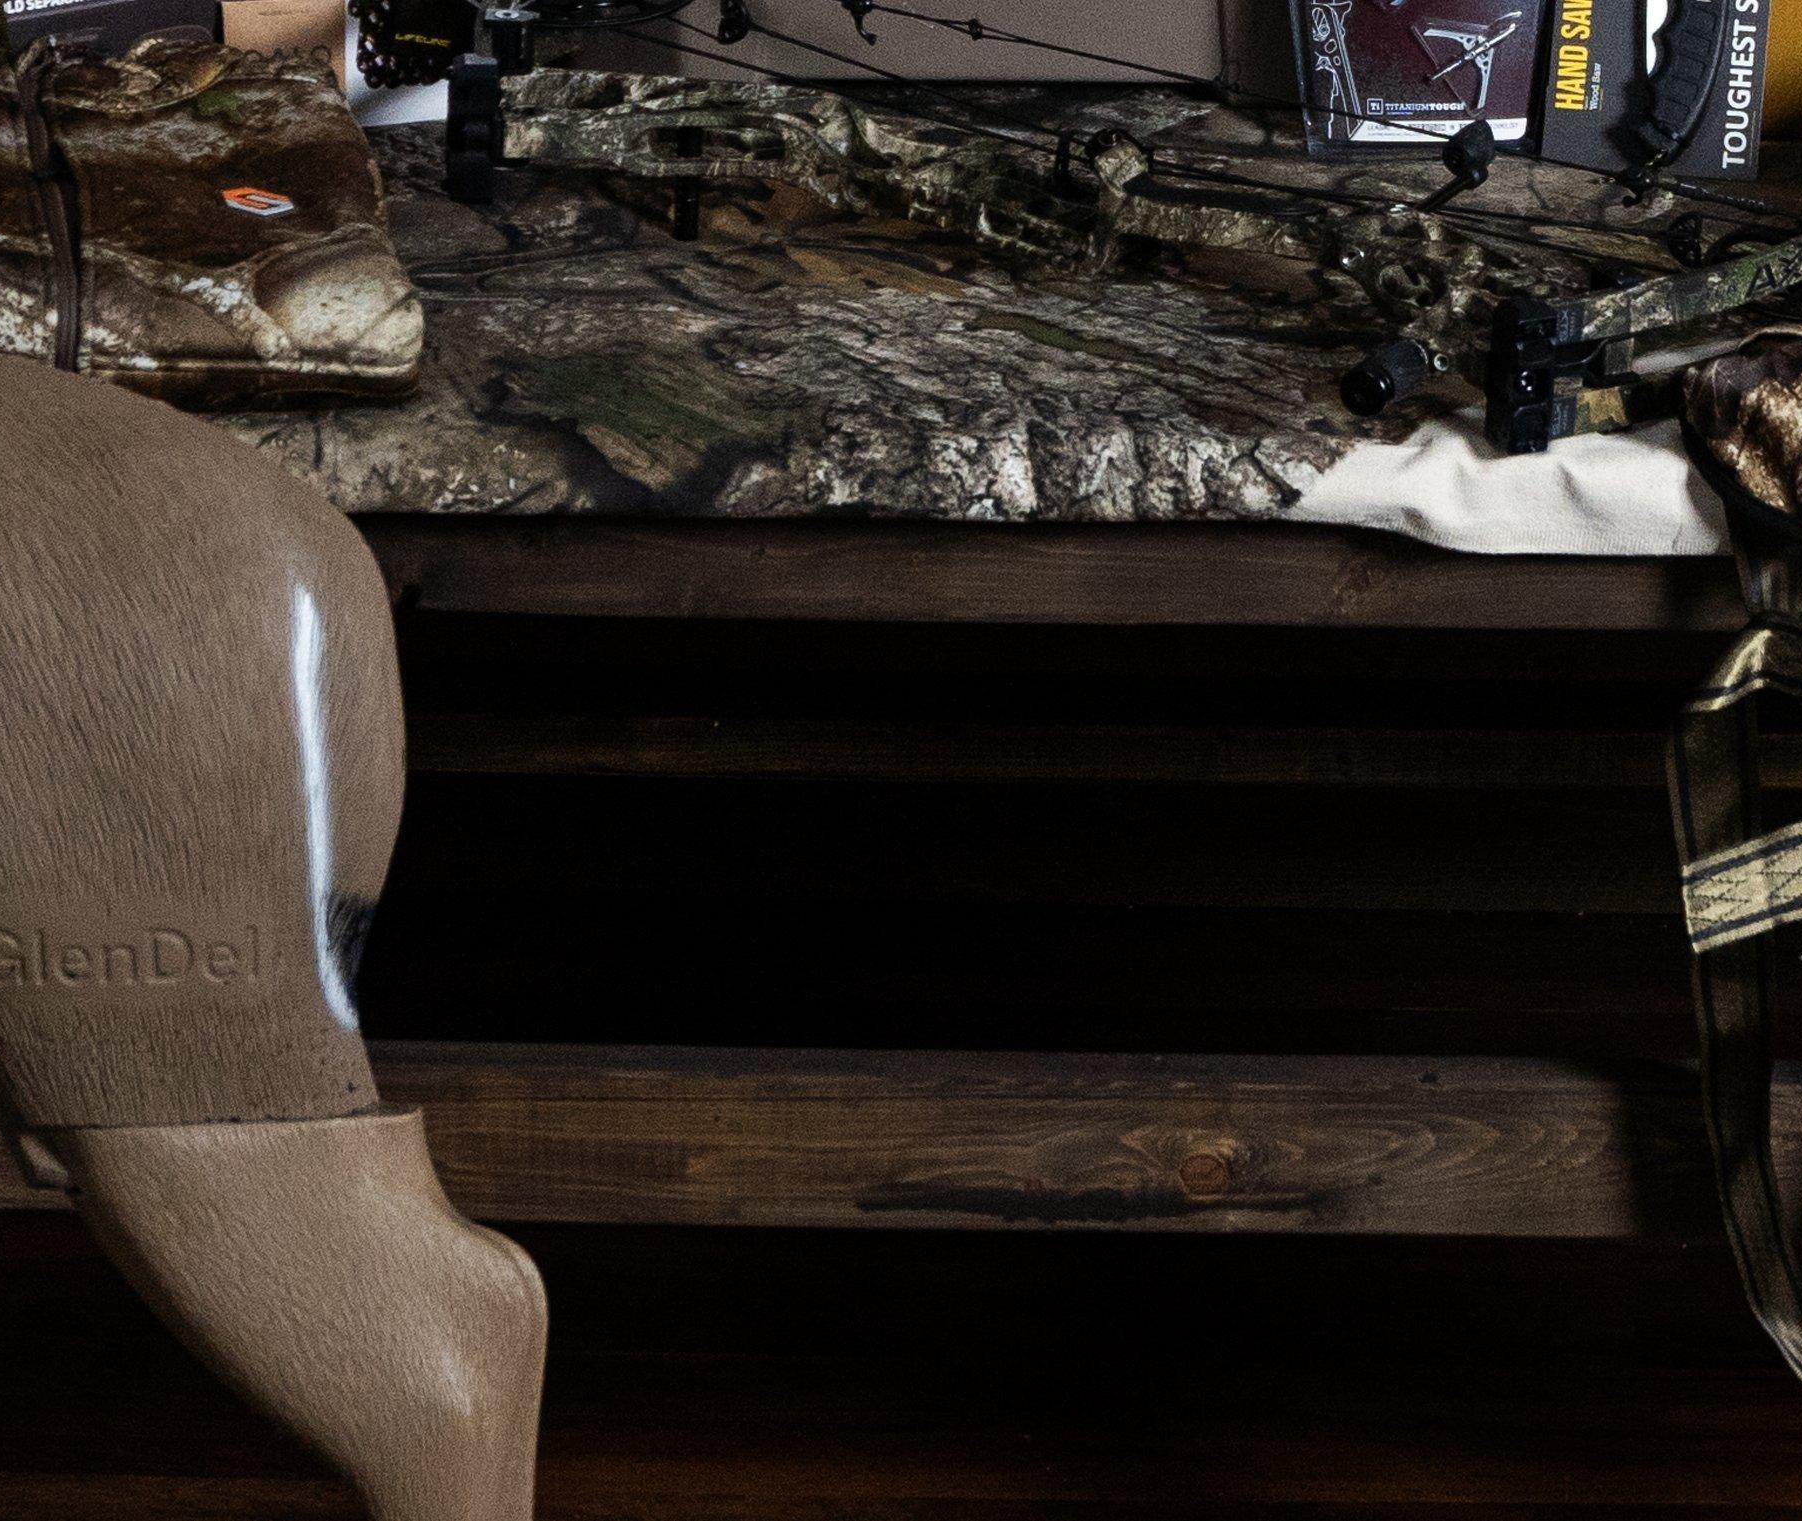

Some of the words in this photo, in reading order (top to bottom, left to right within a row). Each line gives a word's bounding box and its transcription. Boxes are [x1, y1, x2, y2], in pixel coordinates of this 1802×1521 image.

[1554, 44, 1589, 111] HAND
[1591, 62, 1602, 84] Saw
[1722, 20, 1758, 169] TOUGHEST
[1589, 84, 1600, 111] Wood
